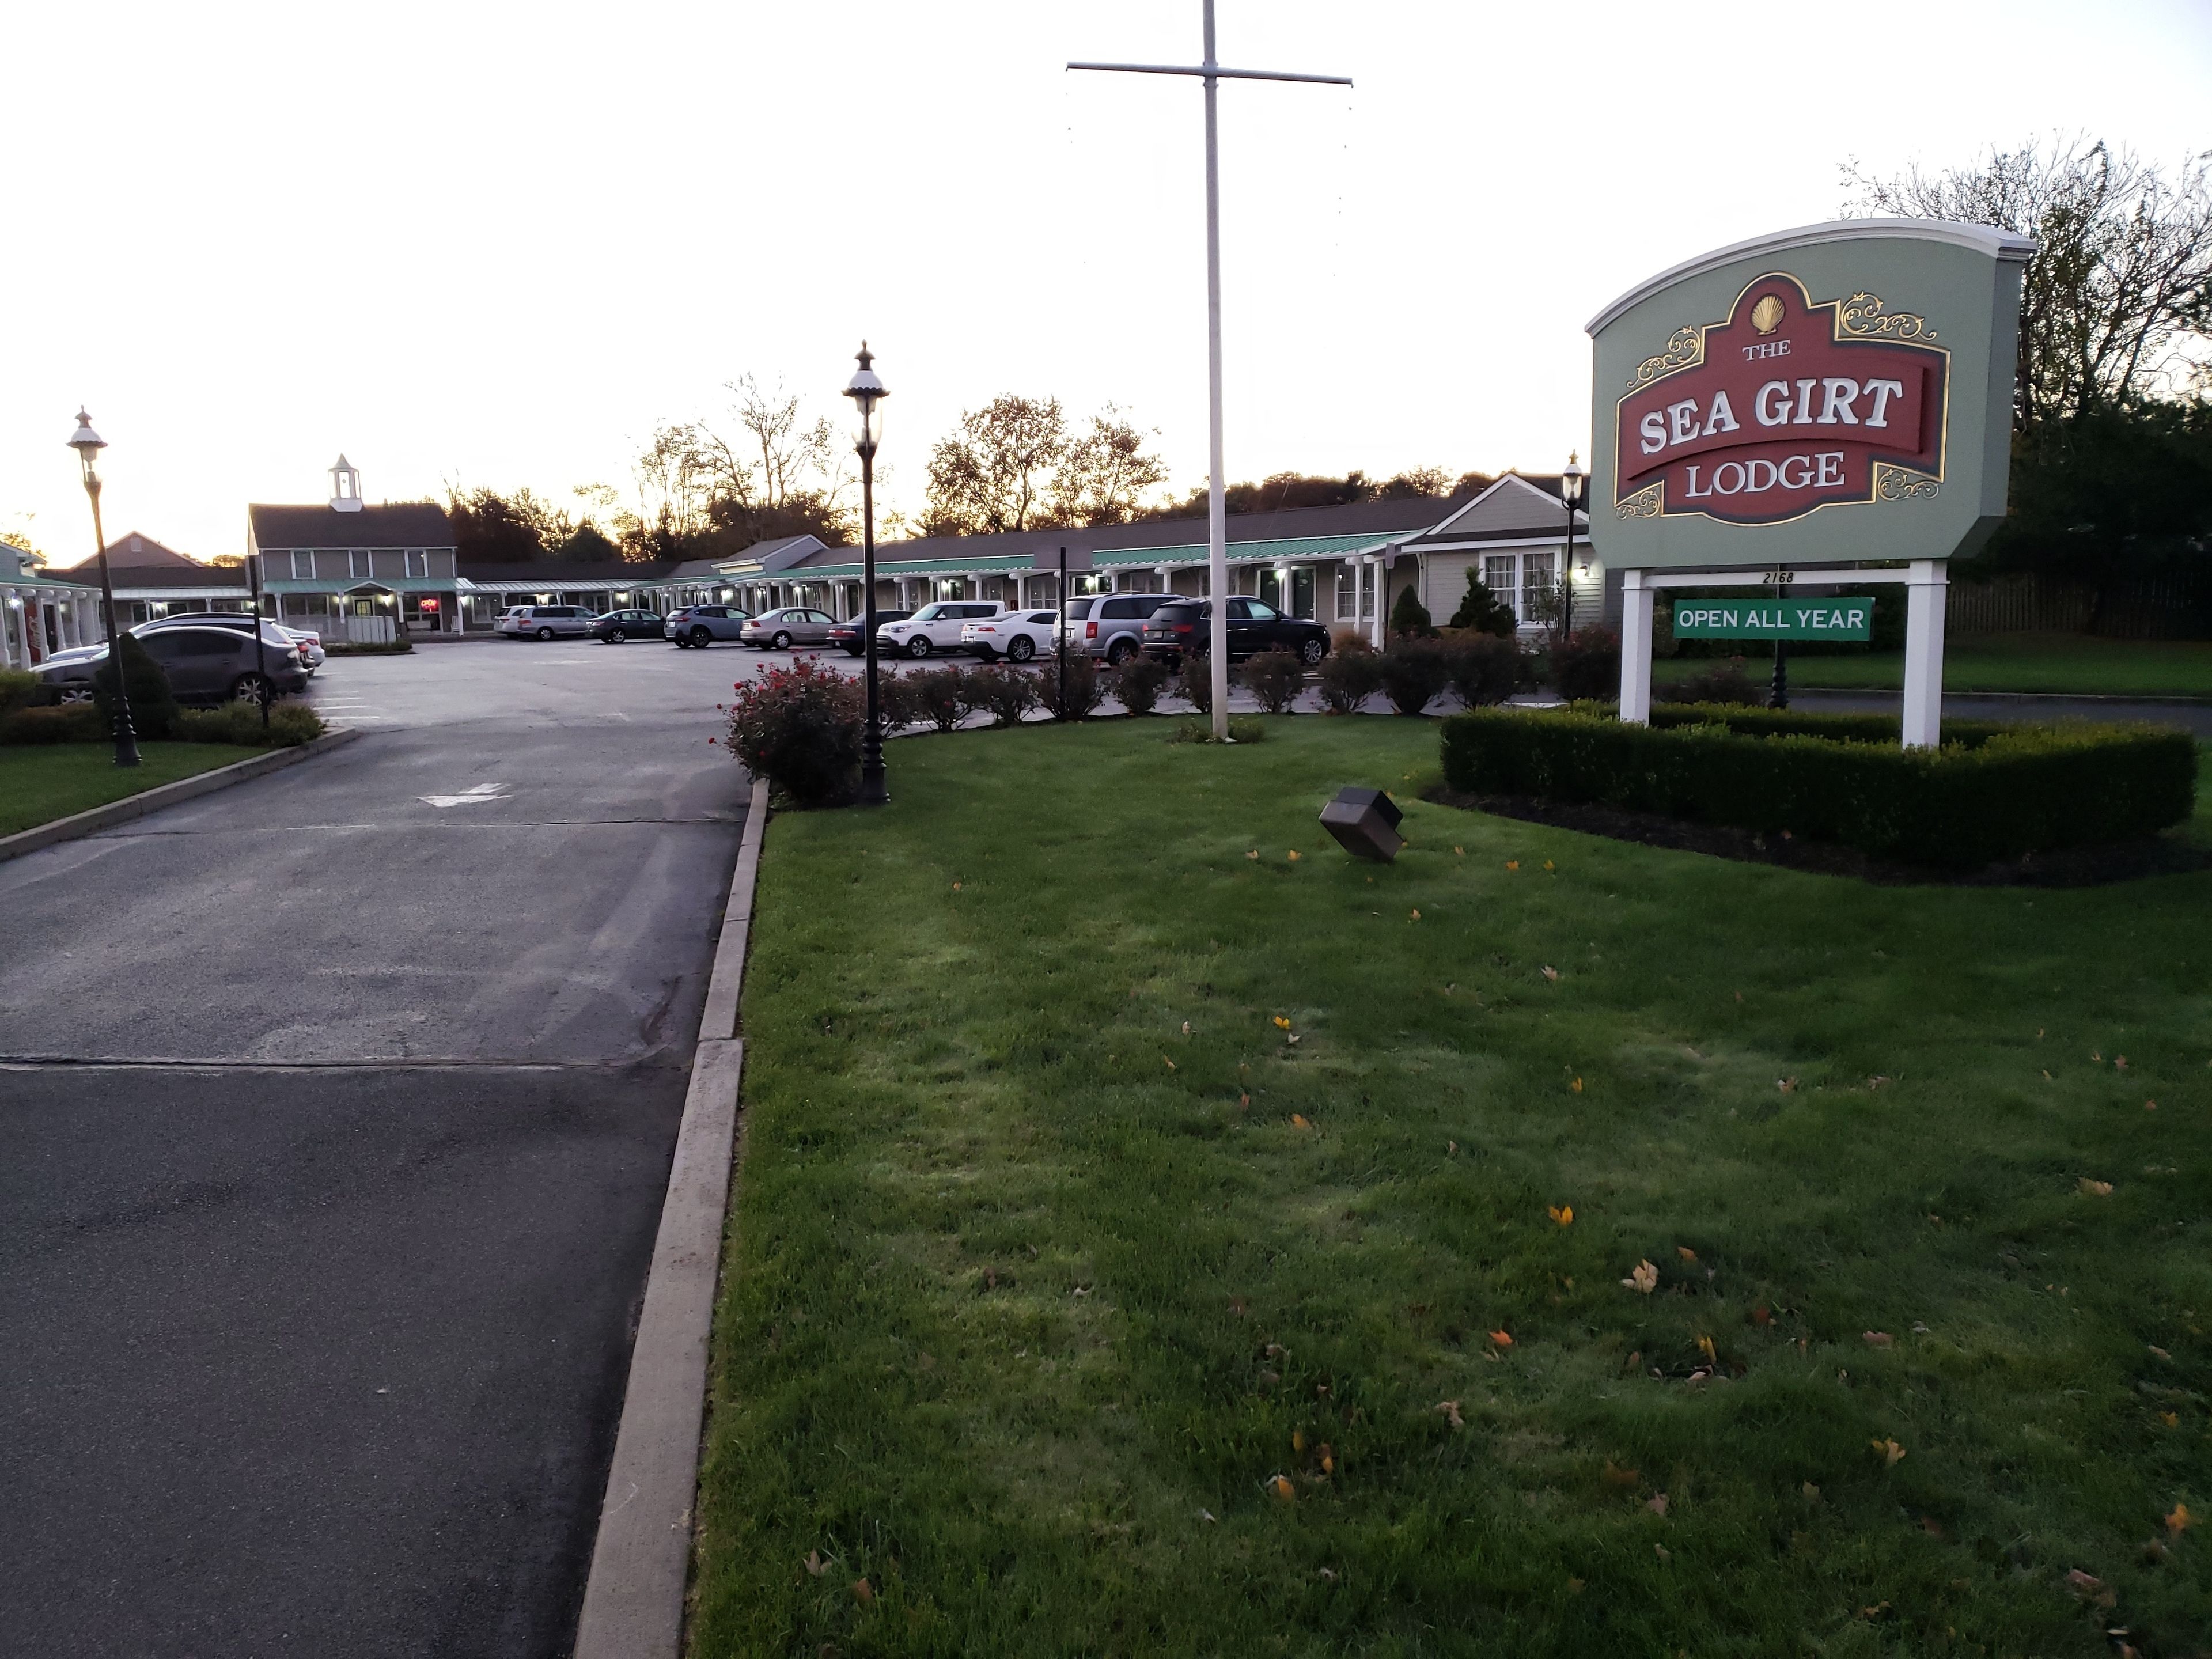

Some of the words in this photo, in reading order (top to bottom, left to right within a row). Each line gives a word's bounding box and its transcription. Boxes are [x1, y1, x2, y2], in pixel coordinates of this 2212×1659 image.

[1742, 340, 1791, 361] THE
[1640, 391, 1740, 455] SEA
[1755, 377, 1903, 428] GIRT
[1685, 452, 1846, 497] LODGE
[1763, 573, 1793, 583] 2168
[1679, 609, 1738, 627] OPEN
[1745, 609, 1790, 628] ALL
[1796, 609, 1864, 628] YEAR
